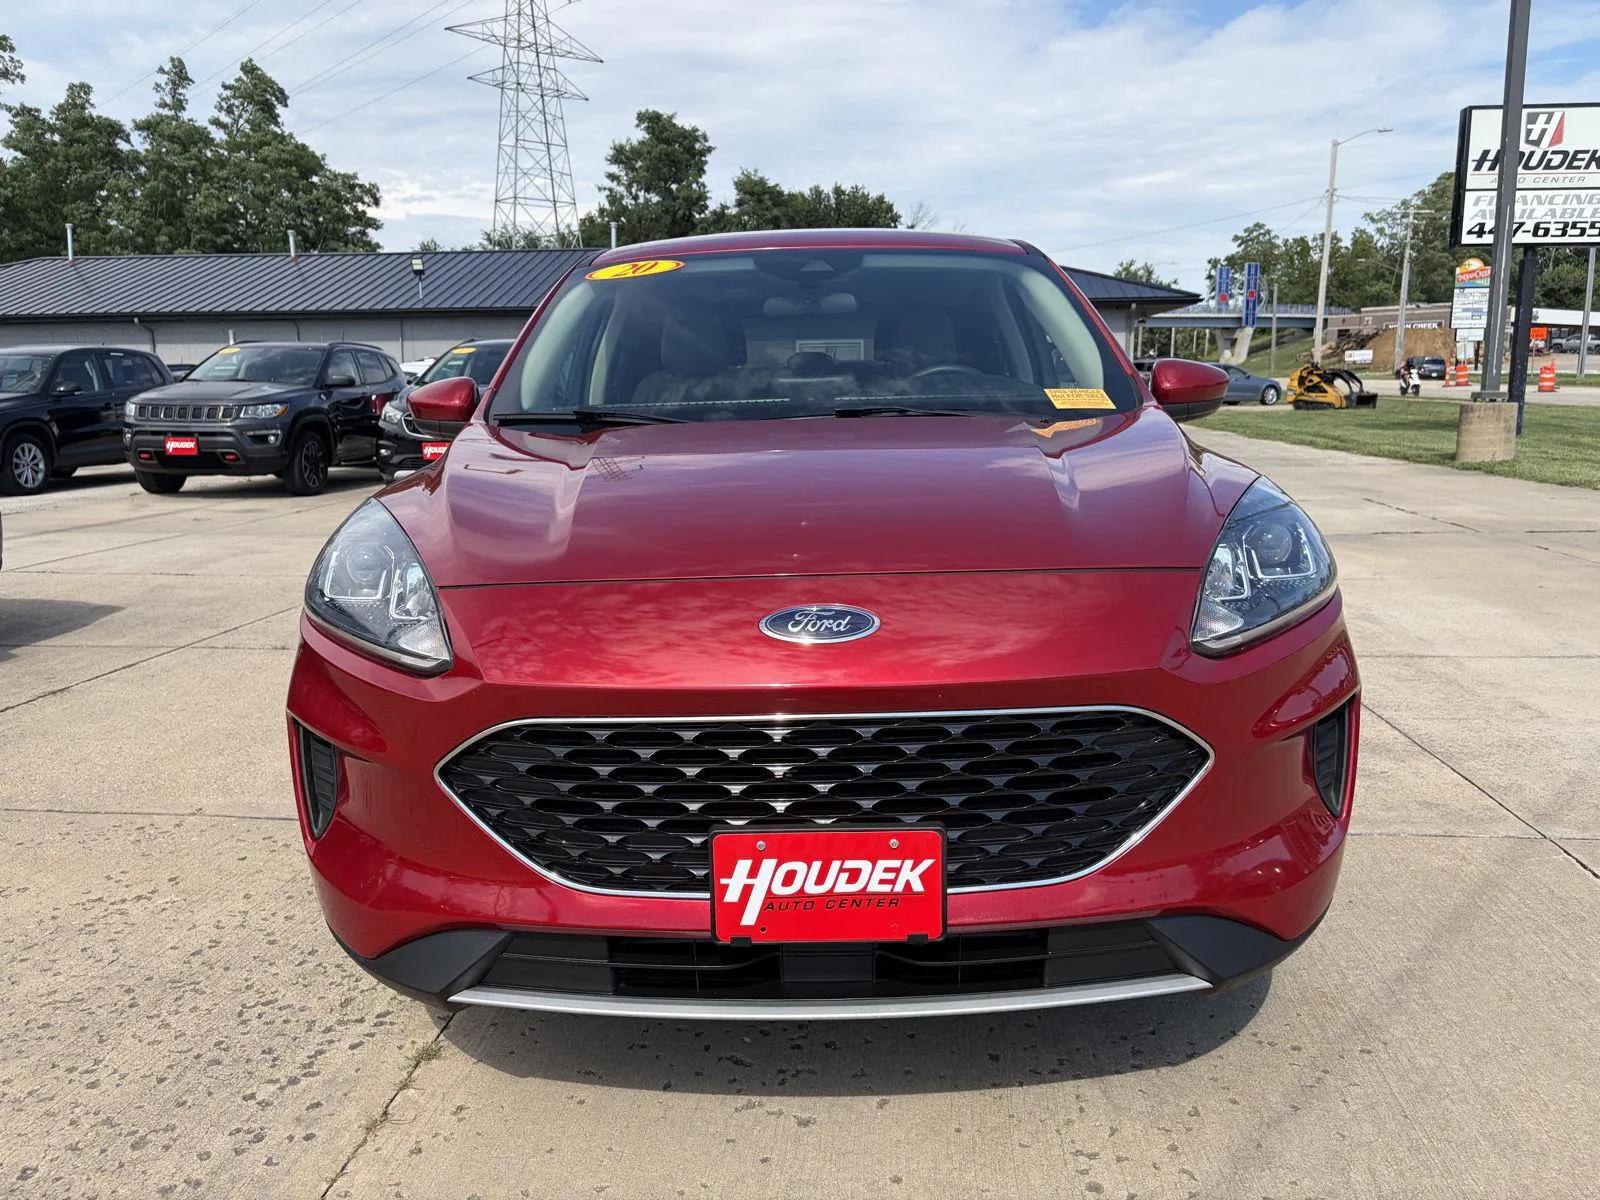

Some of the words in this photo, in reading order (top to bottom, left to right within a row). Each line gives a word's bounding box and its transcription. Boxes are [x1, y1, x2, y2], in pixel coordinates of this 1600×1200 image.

[1489, 176, 1526, 184] AO
[1533, 176, 1586, 184] CENTER
[1472, 193, 1600, 207] FIANCING
[1470, 207, 1600, 221] AILABLE
[610, 261, 659, 278] 20
[166, 441, 196, 453] HOUDEK
[787, 610, 852, 632] Ford
[720, 858, 936, 926] HOUDEK
[763, 900, 816, 912] AUTO
[825, 898, 900, 910] CENTER
